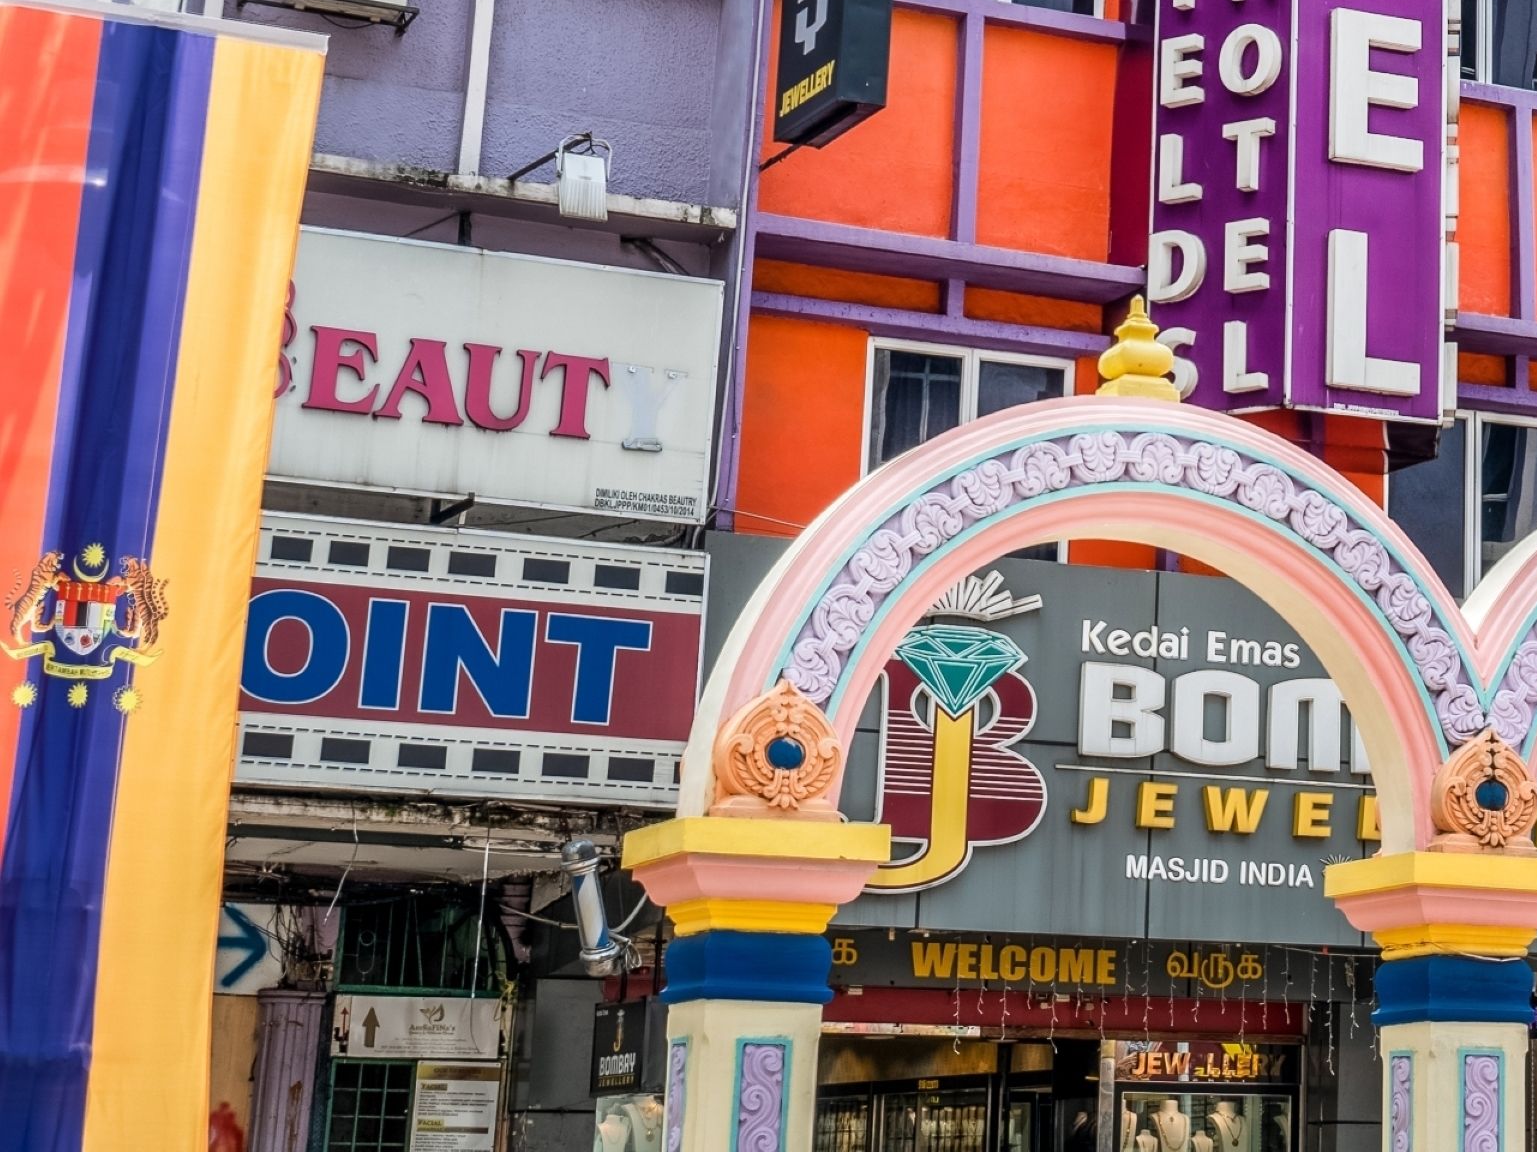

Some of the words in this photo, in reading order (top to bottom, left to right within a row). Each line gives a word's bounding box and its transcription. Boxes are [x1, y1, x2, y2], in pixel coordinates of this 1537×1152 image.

[779, 60, 836, 118] JEWELLERY
[621, 491, 637, 501] OLEH
[638, 493, 667, 505] CHAKRAS
[240, 589, 653, 727] OINT
[1081, 619, 1188, 663] Kedai
[1207, 630, 1301, 668] Emas
[1125, 854, 1229, 885] MASJID
[1239, 860, 1315, 887] INDIA
[911, 942, 1117, 985] WELCOME
[599, 1052, 636, 1077] BOMBAY
